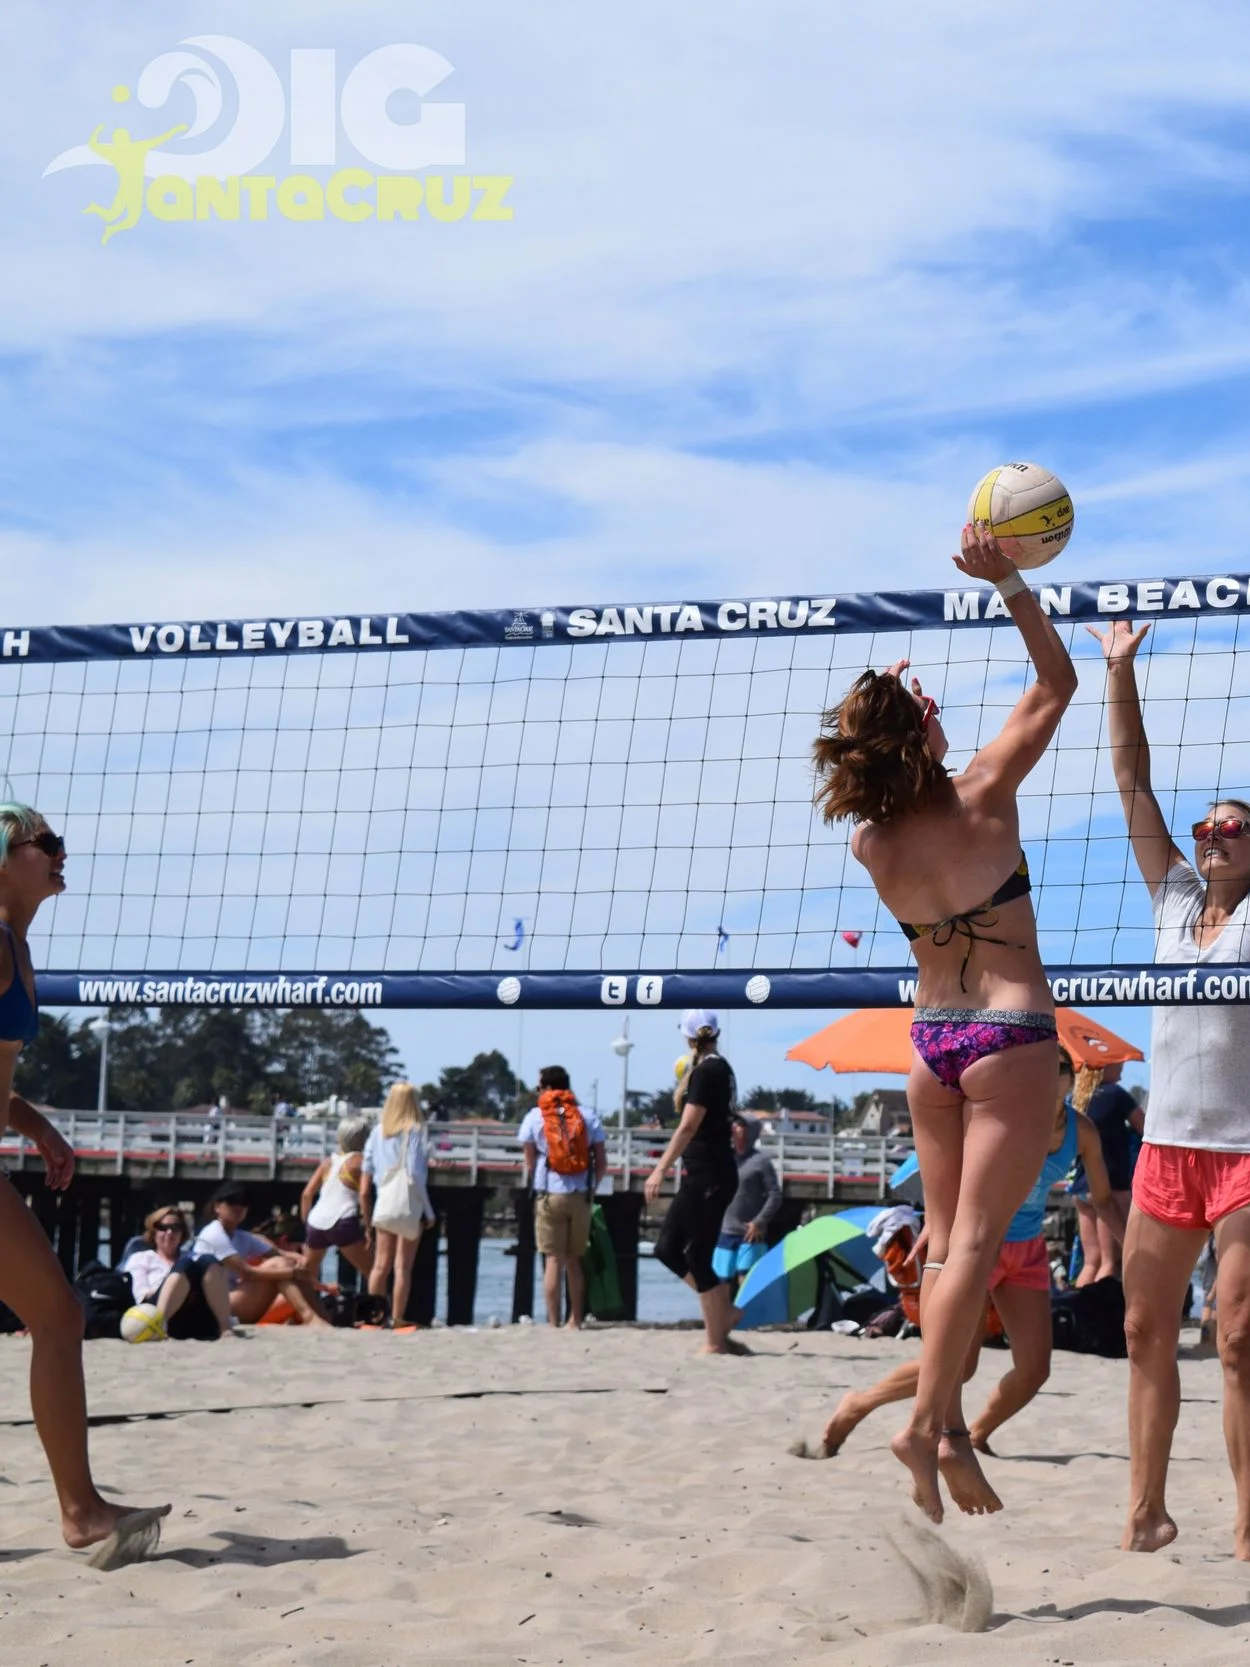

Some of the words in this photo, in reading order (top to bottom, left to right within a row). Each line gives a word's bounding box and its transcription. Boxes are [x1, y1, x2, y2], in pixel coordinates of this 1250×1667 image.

[566, 604, 704, 638] SANTA
[717, 598, 837, 631] CRUZ
[943, 586, 1072, 622] MAN
[129, 617, 410, 653] VOLLEYBALL
[78, 975, 383, 1005] www.santacruzwharf.com
